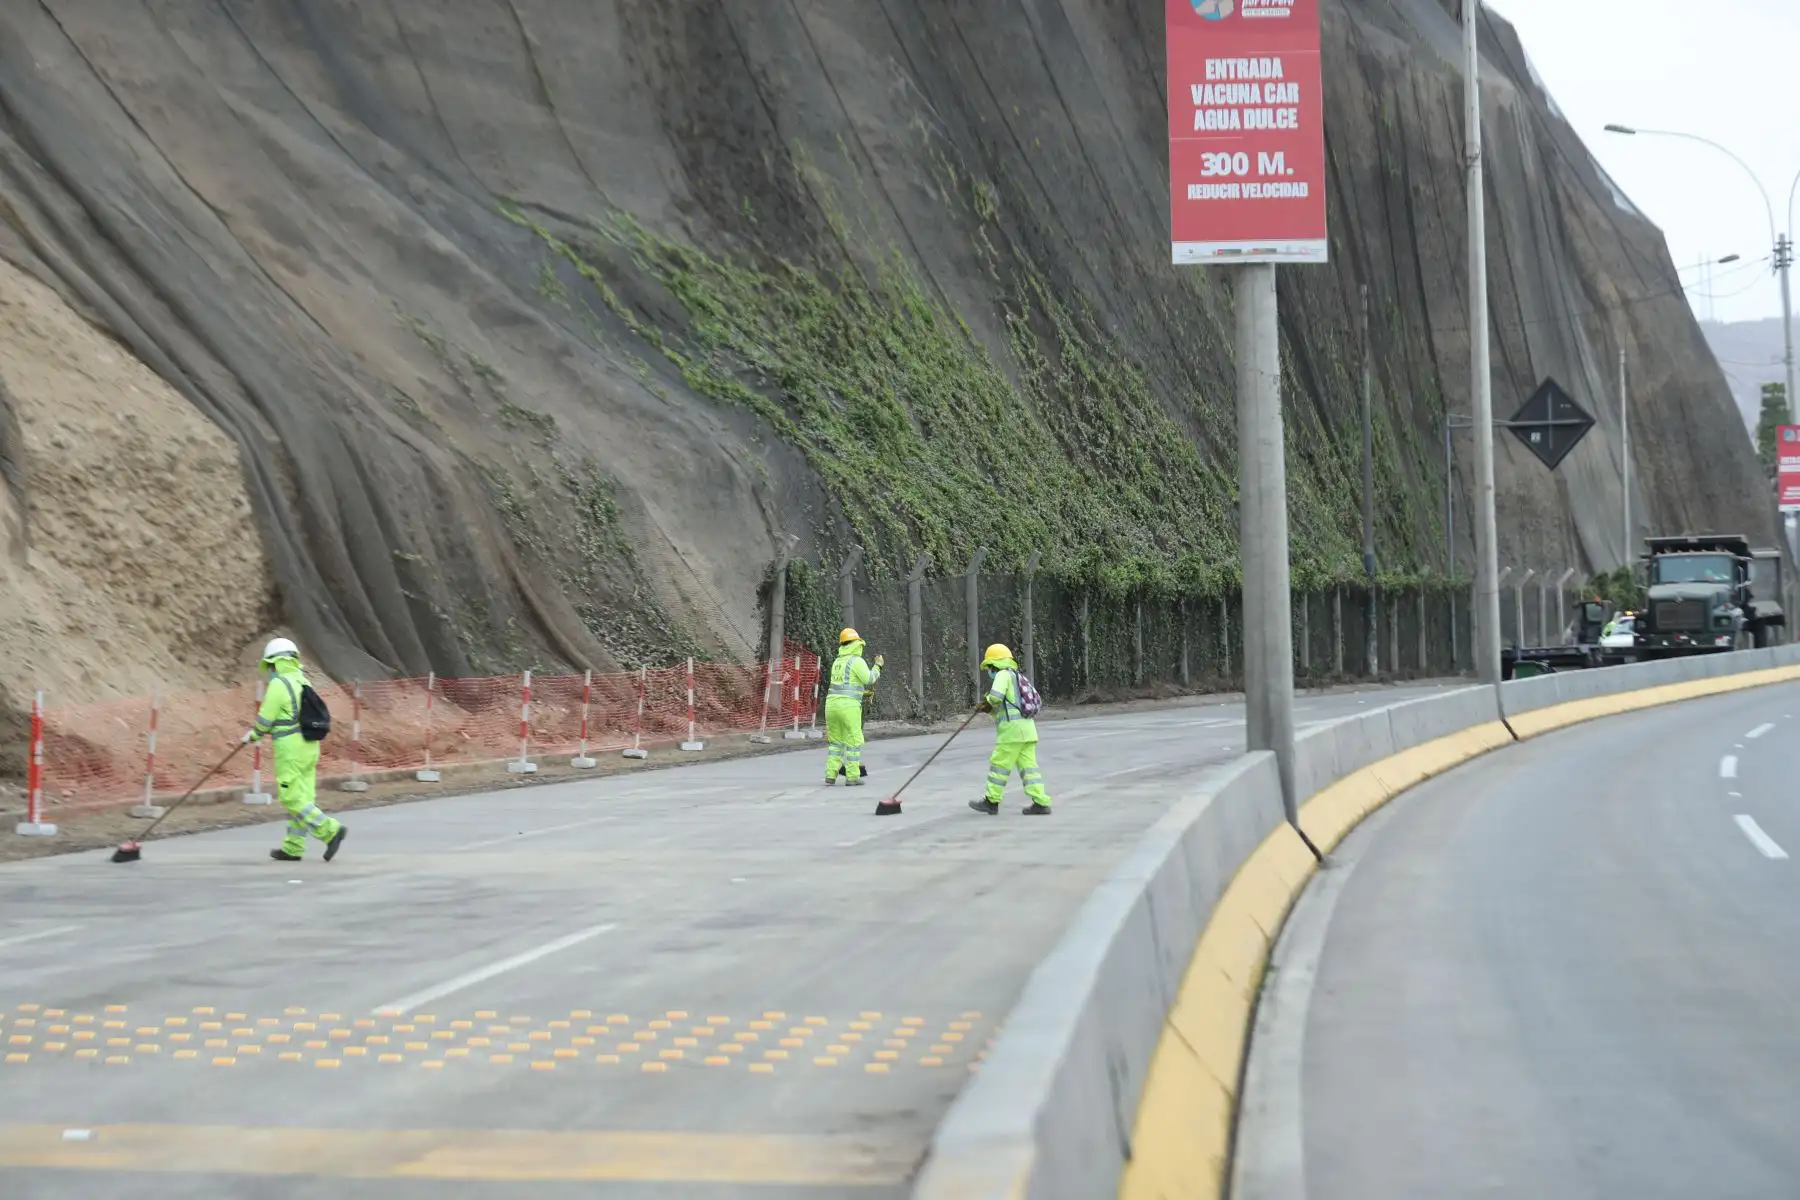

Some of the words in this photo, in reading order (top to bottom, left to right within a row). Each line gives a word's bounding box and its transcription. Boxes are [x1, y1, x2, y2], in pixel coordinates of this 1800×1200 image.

[1205, 57, 1283, 80] ENTRADA
[1191, 83, 1261, 105] VACUNA
[1264, 83, 1299, 104] CAR
[1194, 109, 1241, 131] AGUA
[1244, 107, 1298, 129] DULCE
[1201, 152, 1249, 176] 300
[1258, 151, 1294, 176] M.
[1187, 183, 1240, 200] REDUCIR
[1241, 182, 1309, 199] VELOCIDAD
